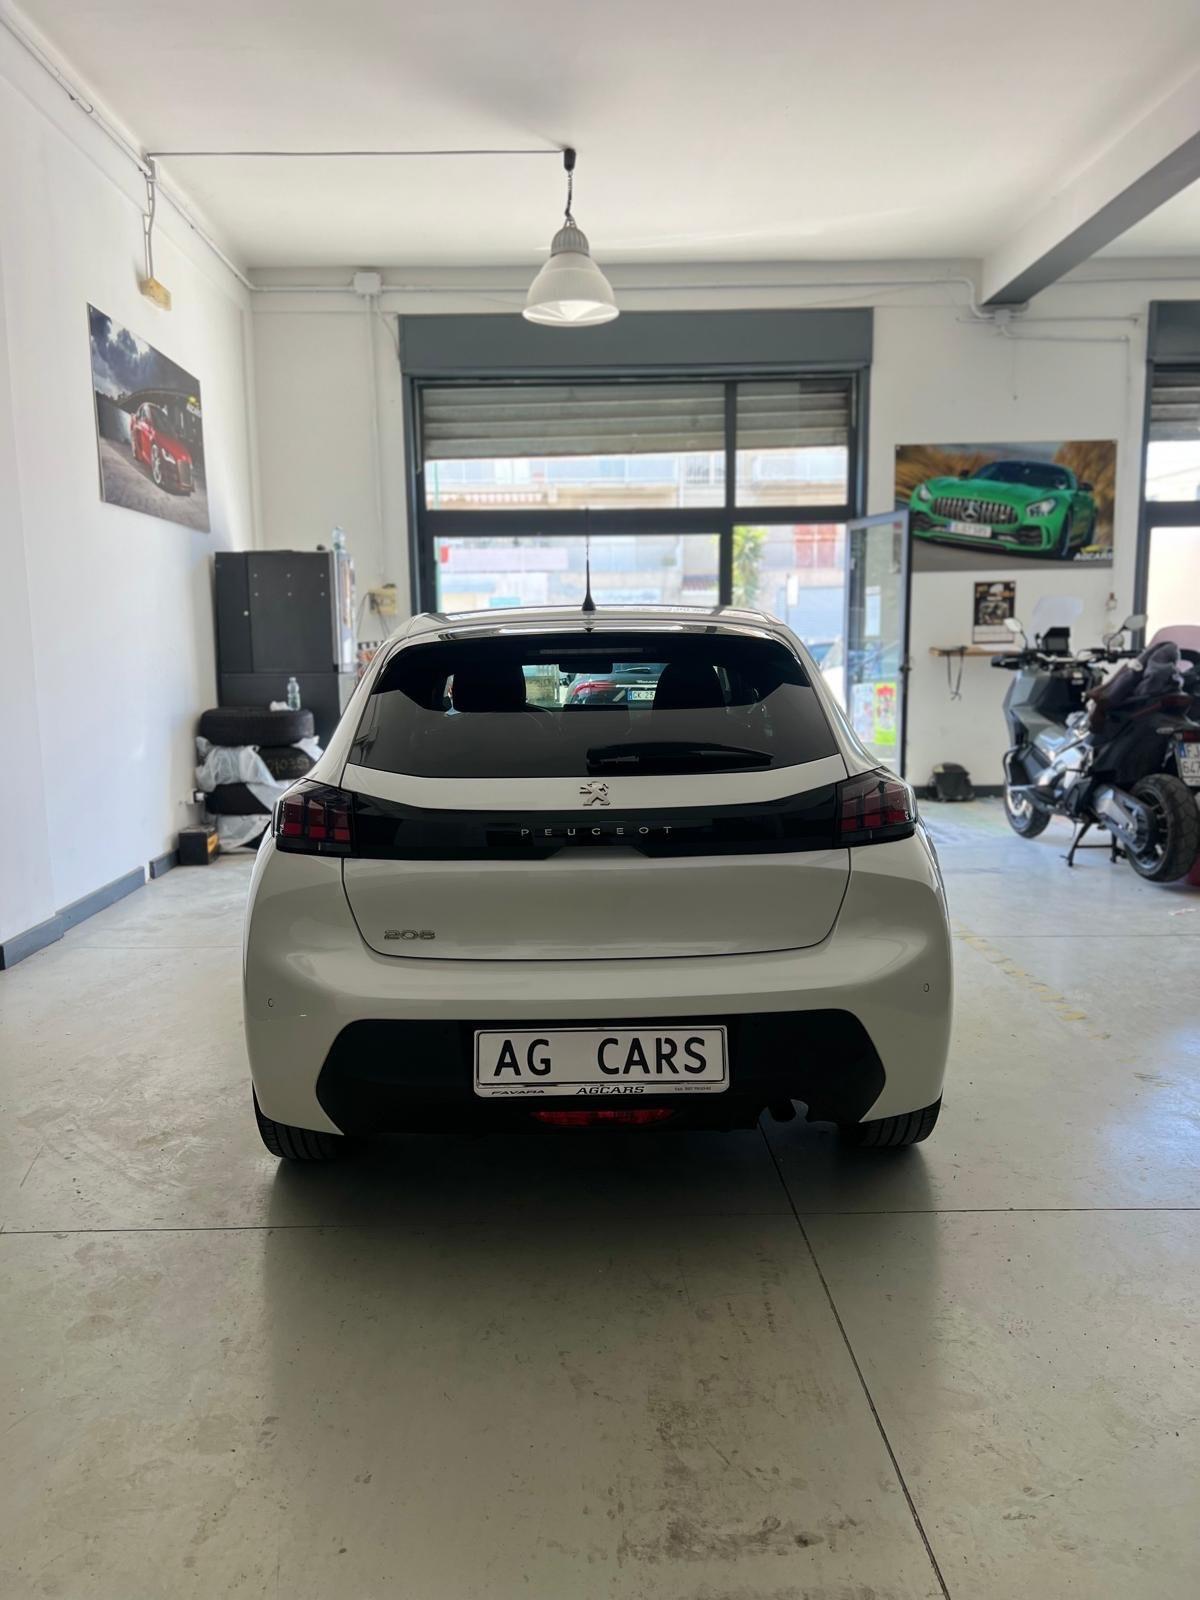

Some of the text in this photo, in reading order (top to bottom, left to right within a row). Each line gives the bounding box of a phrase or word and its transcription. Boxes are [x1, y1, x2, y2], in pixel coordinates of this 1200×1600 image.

[520, 826, 673, 837] PEUGEOT
[384, 929, 436, 940] 208
[493, 1036, 707, 1076] AG CARS
[576, 1086, 645, 1095] AGCARS
